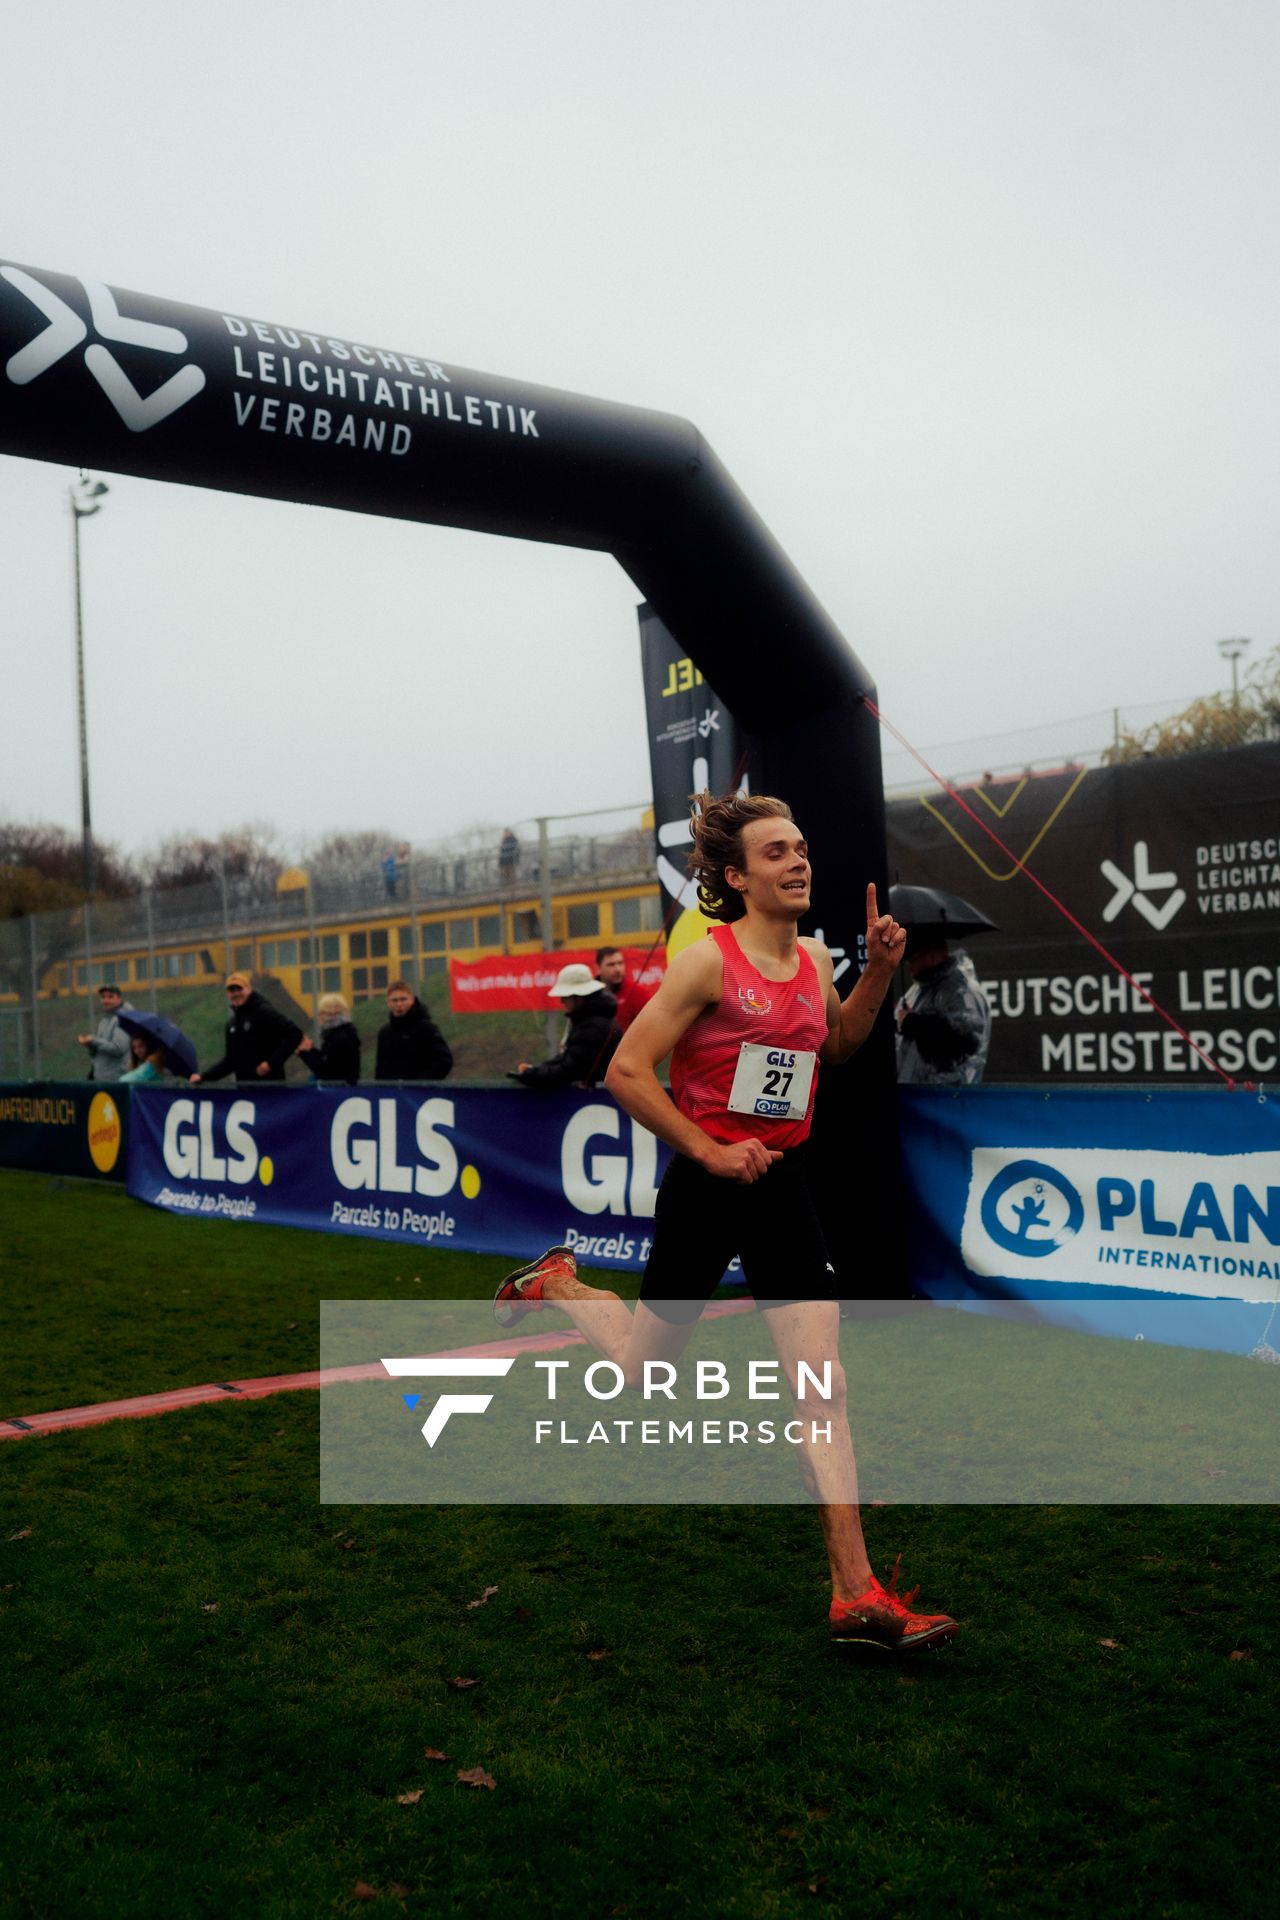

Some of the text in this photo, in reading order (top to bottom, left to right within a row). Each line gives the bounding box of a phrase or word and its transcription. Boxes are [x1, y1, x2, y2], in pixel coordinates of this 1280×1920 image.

[222, 315, 451, 383] DEUTSCHER
[233, 346, 540, 438] LEICHTATHLETIK
[233, 392, 412, 456] VERBAND
[1196, 838, 1280, 866] DEUTSC
[1197, 889, 1280, 914] VERBAN
[980, 966, 1280, 1018] EUTSCHE LEIC
[762, 1070, 793, 1097] 27
[561, 1104, 659, 1218] GL
[214, 1193, 257, 1220] People
[331, 1201, 455, 1241] Parcels to People
[1097, 1177, 1280, 1247] PLAN
[564, 1228, 635, 1260] Parcels
